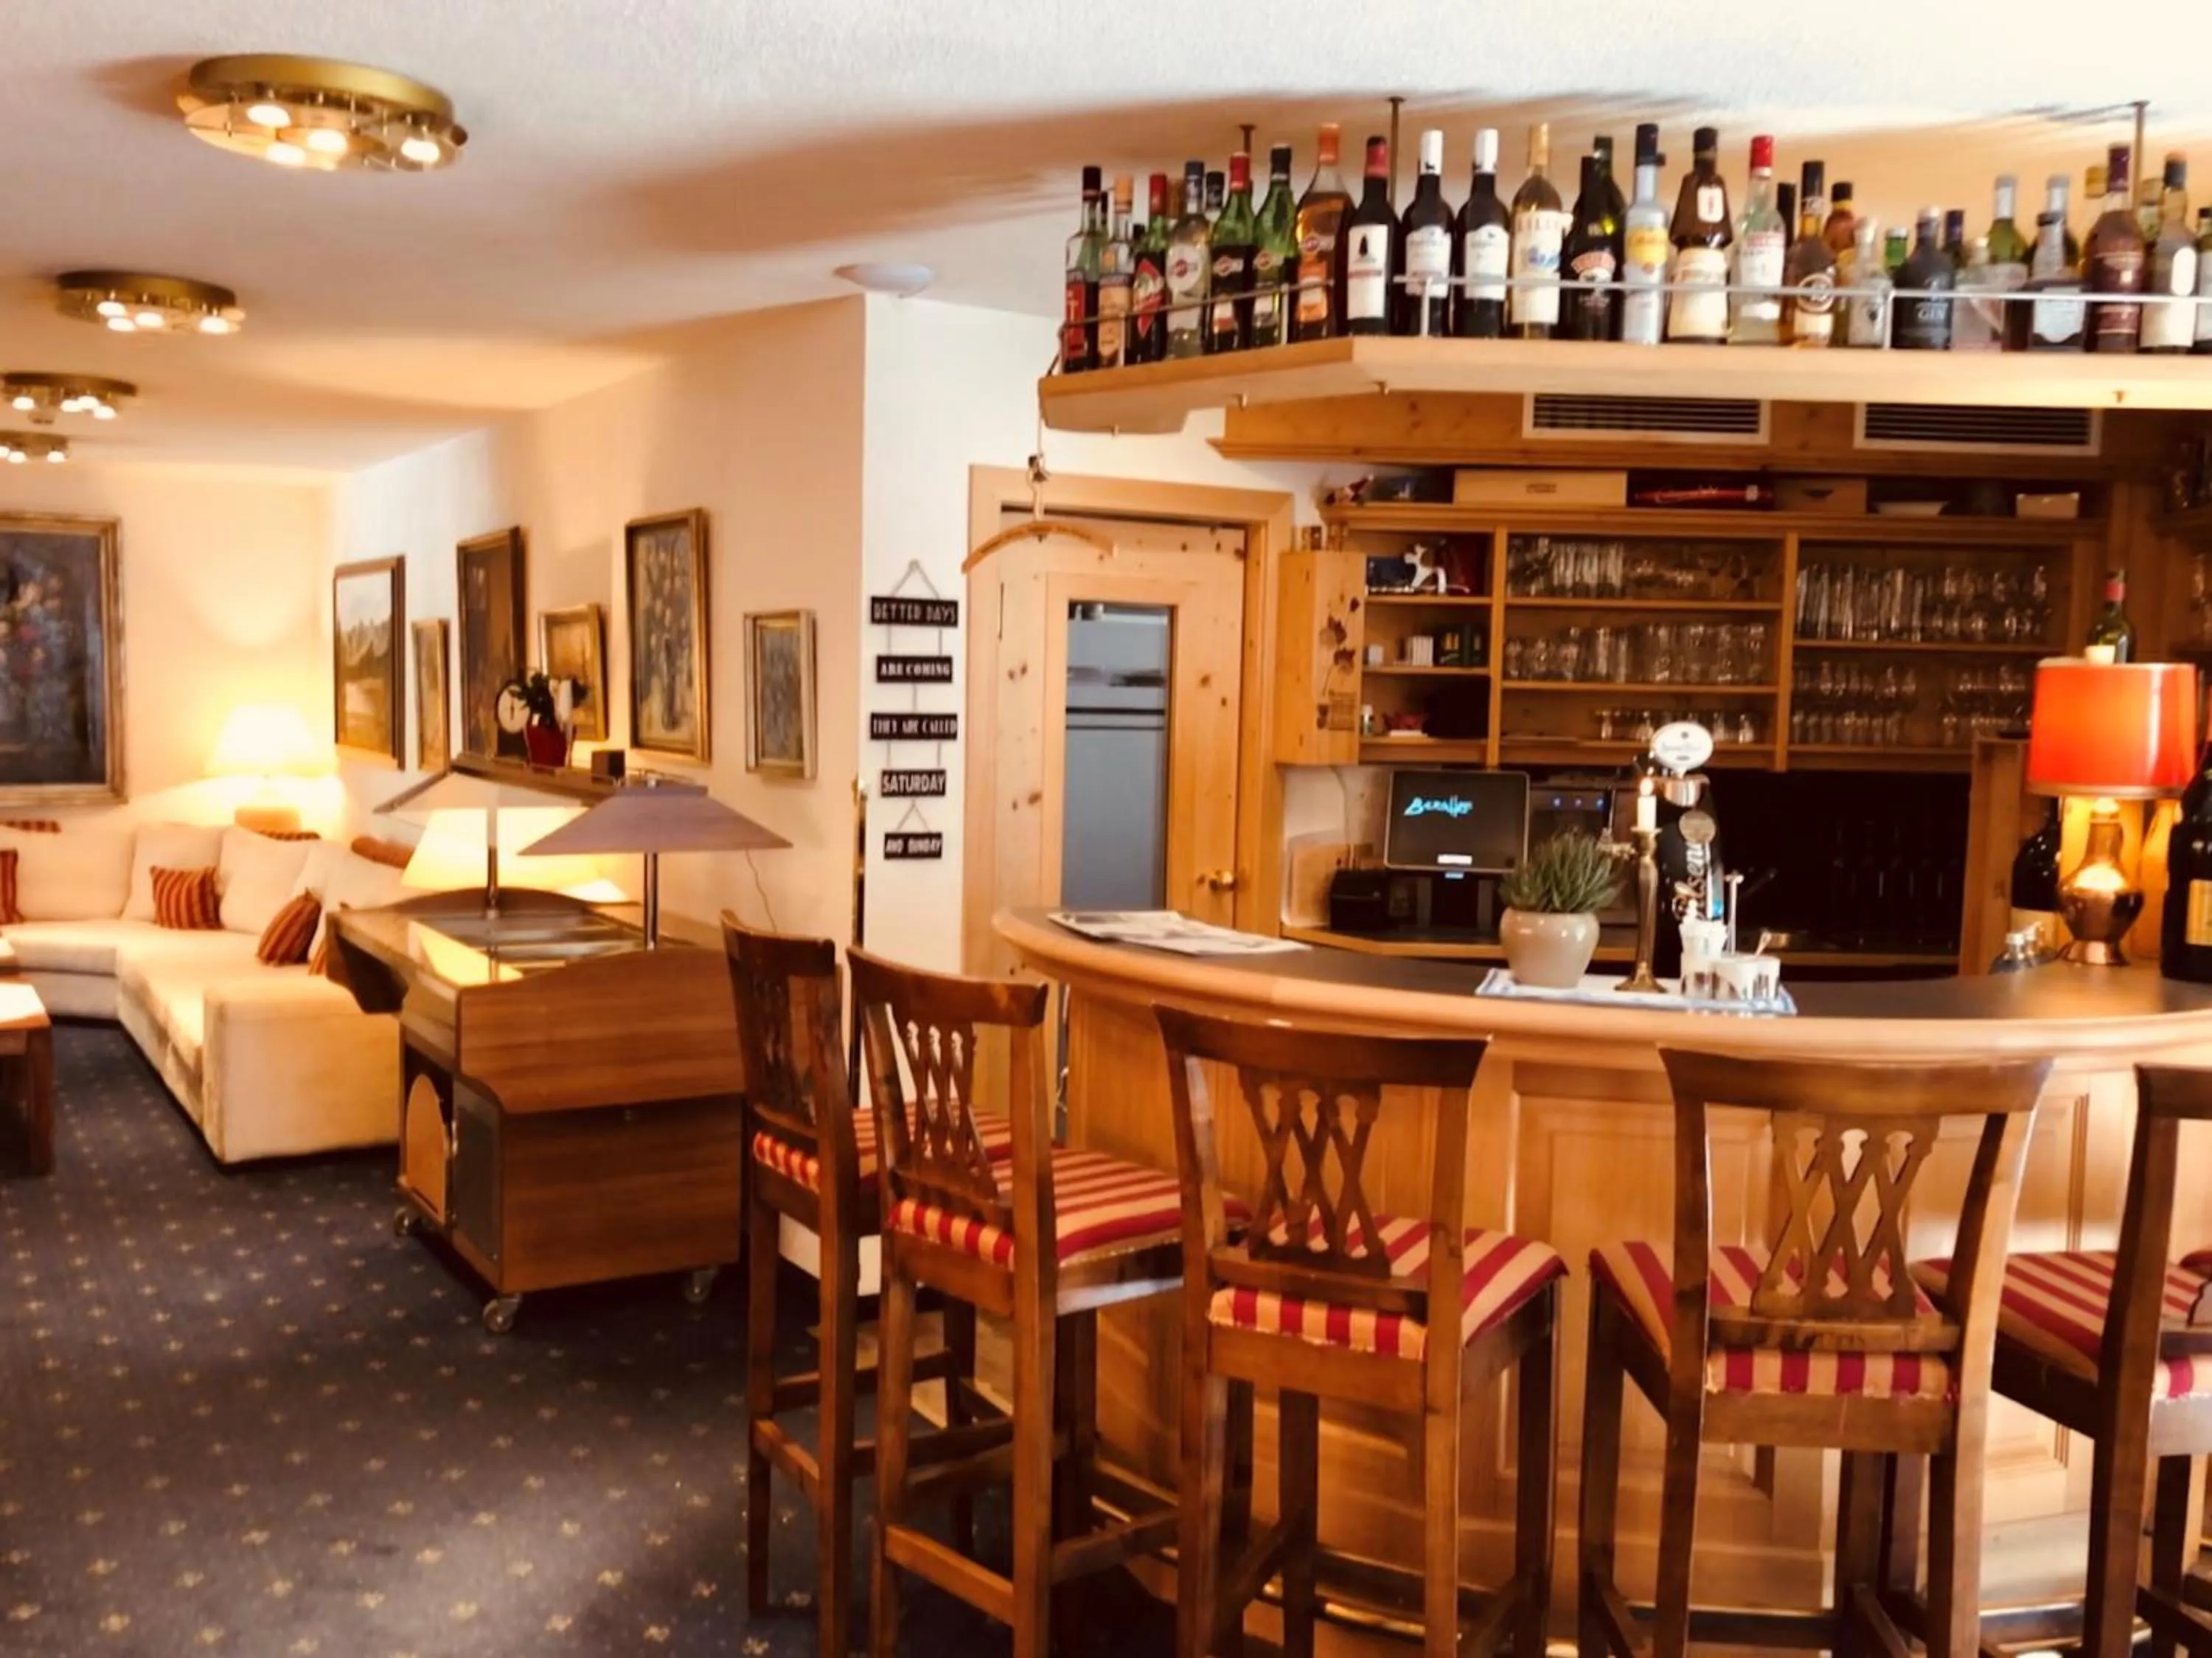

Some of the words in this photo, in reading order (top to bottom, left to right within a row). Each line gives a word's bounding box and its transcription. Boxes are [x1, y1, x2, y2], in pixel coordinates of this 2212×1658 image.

[925, 605, 956, 622] DAYS
[880, 662, 903, 676] ARE
[905, 662, 950, 677] COMING
[883, 774, 945, 793] SATURDAY
